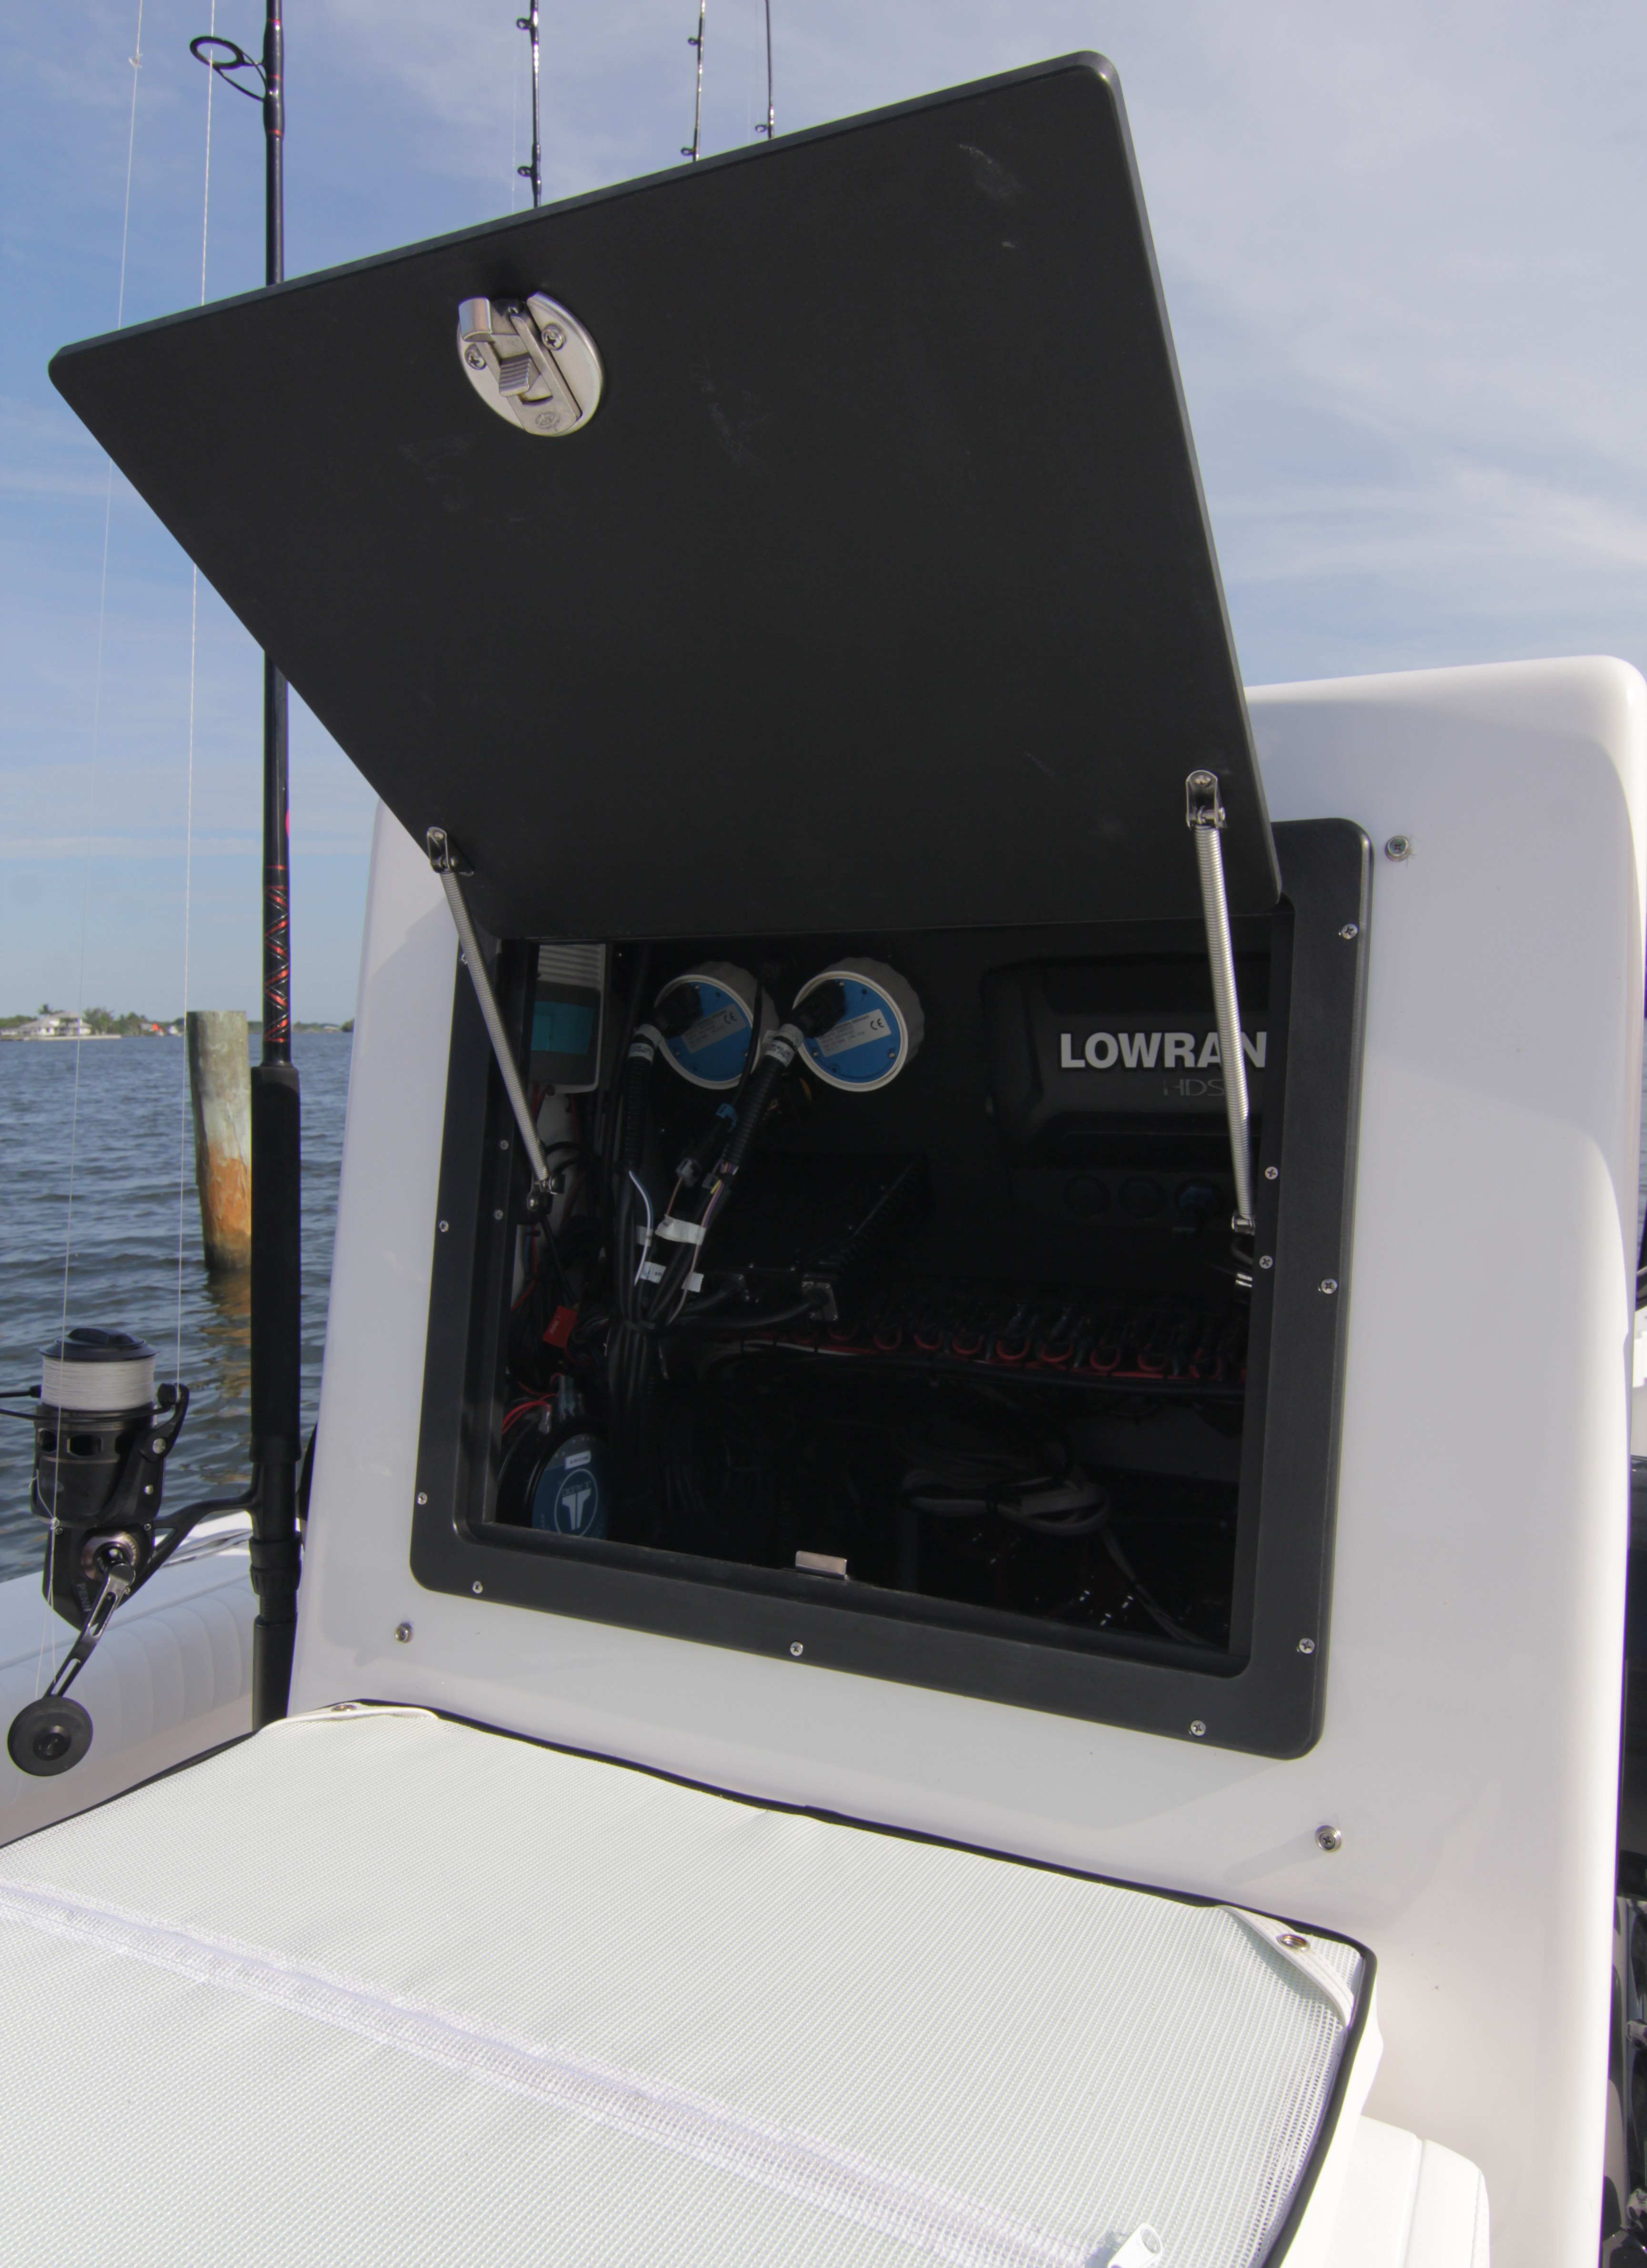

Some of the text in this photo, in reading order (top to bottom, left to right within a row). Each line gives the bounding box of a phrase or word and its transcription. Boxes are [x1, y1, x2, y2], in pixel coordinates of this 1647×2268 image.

[723, 1012, 737, 1024] CE
[870, 1018, 885, 1030] CE
[1163, 1078, 1227, 1096] HDS
[77, 1583, 92, 1612] PENN
